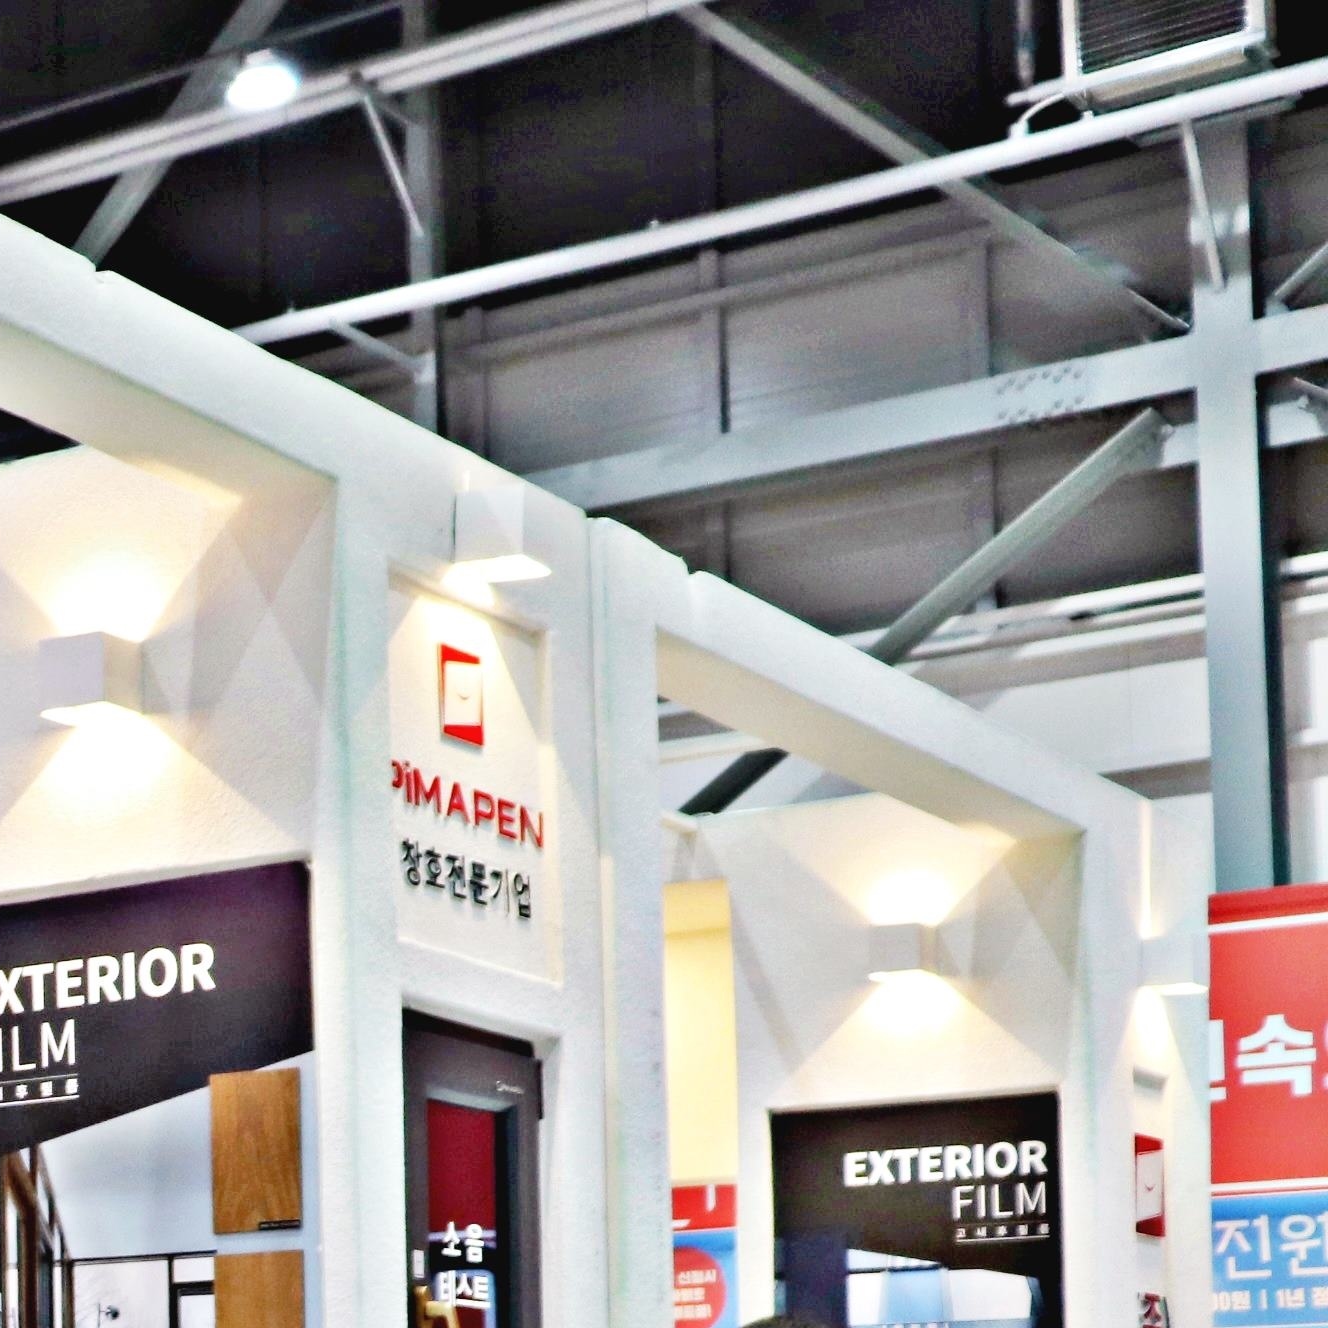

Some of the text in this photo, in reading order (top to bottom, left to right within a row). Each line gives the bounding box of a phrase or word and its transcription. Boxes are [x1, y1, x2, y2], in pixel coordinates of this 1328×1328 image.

[402, 838, 532, 919] 창호전문기업
[844, 1140, 1048, 1187] EXTERIOR
[952, 1181, 1047, 1221] FILM
[441, 1221, 485, 1263] 소음
[435, 1269, 491, 1309] 테스트
